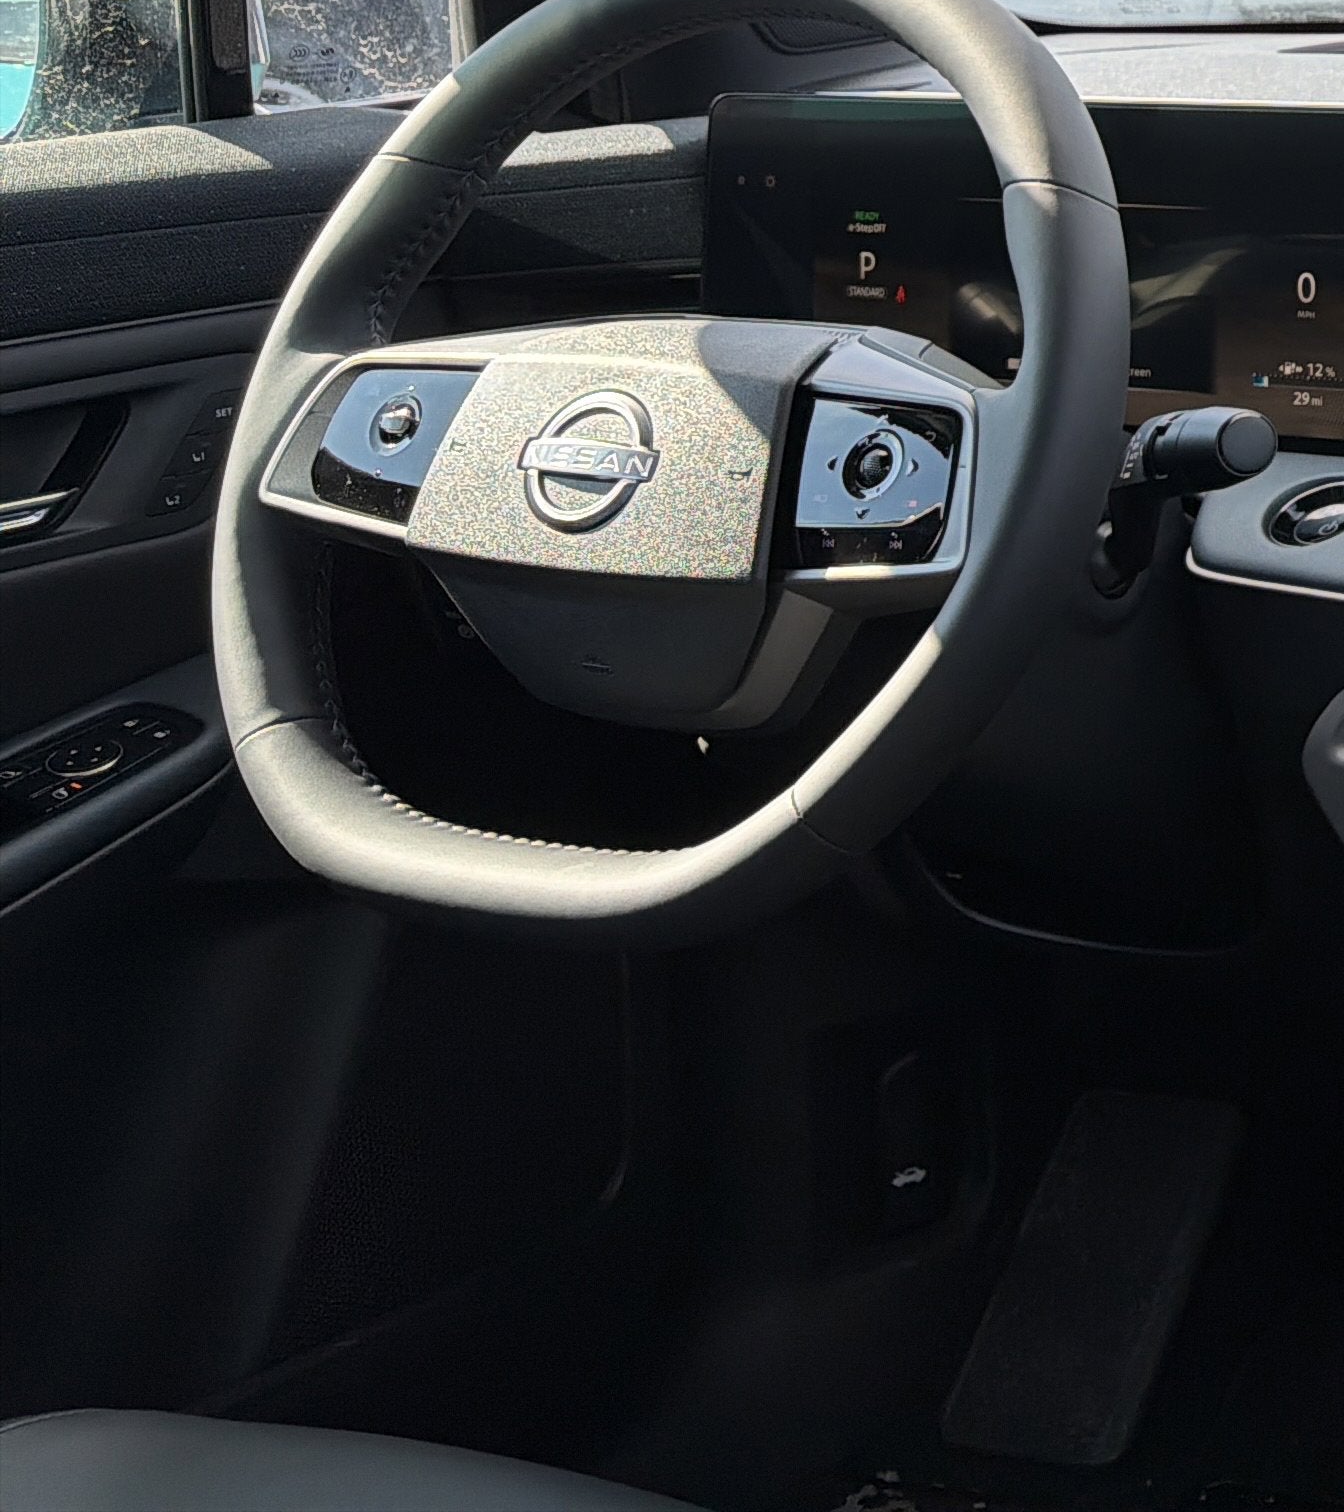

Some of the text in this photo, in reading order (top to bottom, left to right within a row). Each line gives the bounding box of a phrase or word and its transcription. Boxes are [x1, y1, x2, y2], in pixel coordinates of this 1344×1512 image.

[855, 211, 879, 220] READY
[860, 251, 875, 280] P
[848, 286, 885, 297] STANDARD
[1297, 272, 1316, 303] 0
[1297, 311, 1315, 319] MPH
[1293, 392, 1310, 406] 29
[216, 407, 233, 418] SET
[521, 443, 653, 477] NISSAN
